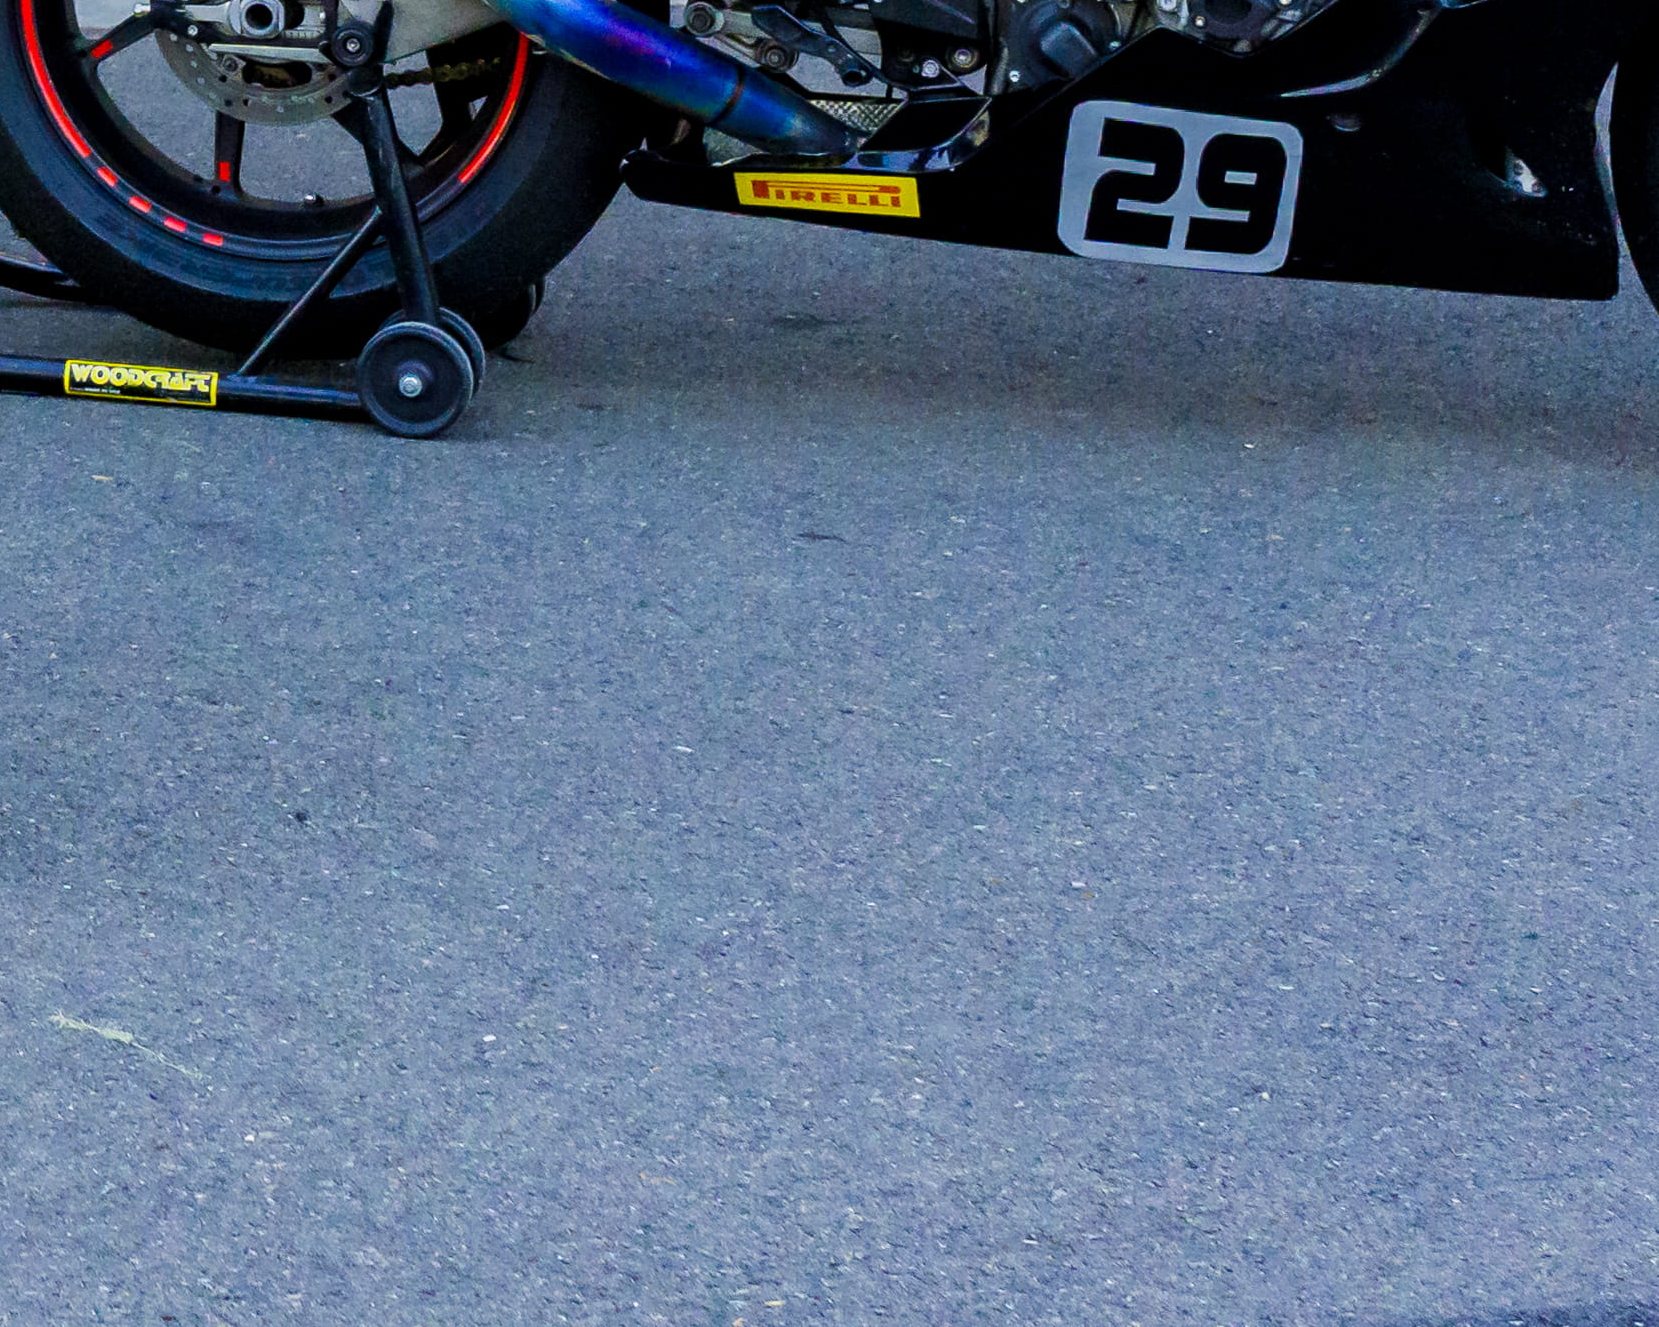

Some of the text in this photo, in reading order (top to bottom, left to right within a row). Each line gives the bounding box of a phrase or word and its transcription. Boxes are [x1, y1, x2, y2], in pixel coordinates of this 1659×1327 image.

[751, 179, 902, 208] PIRELLI
[1083, 117, 1288, 255] 29
[71, 363, 211, 393] WOODCRAFT
